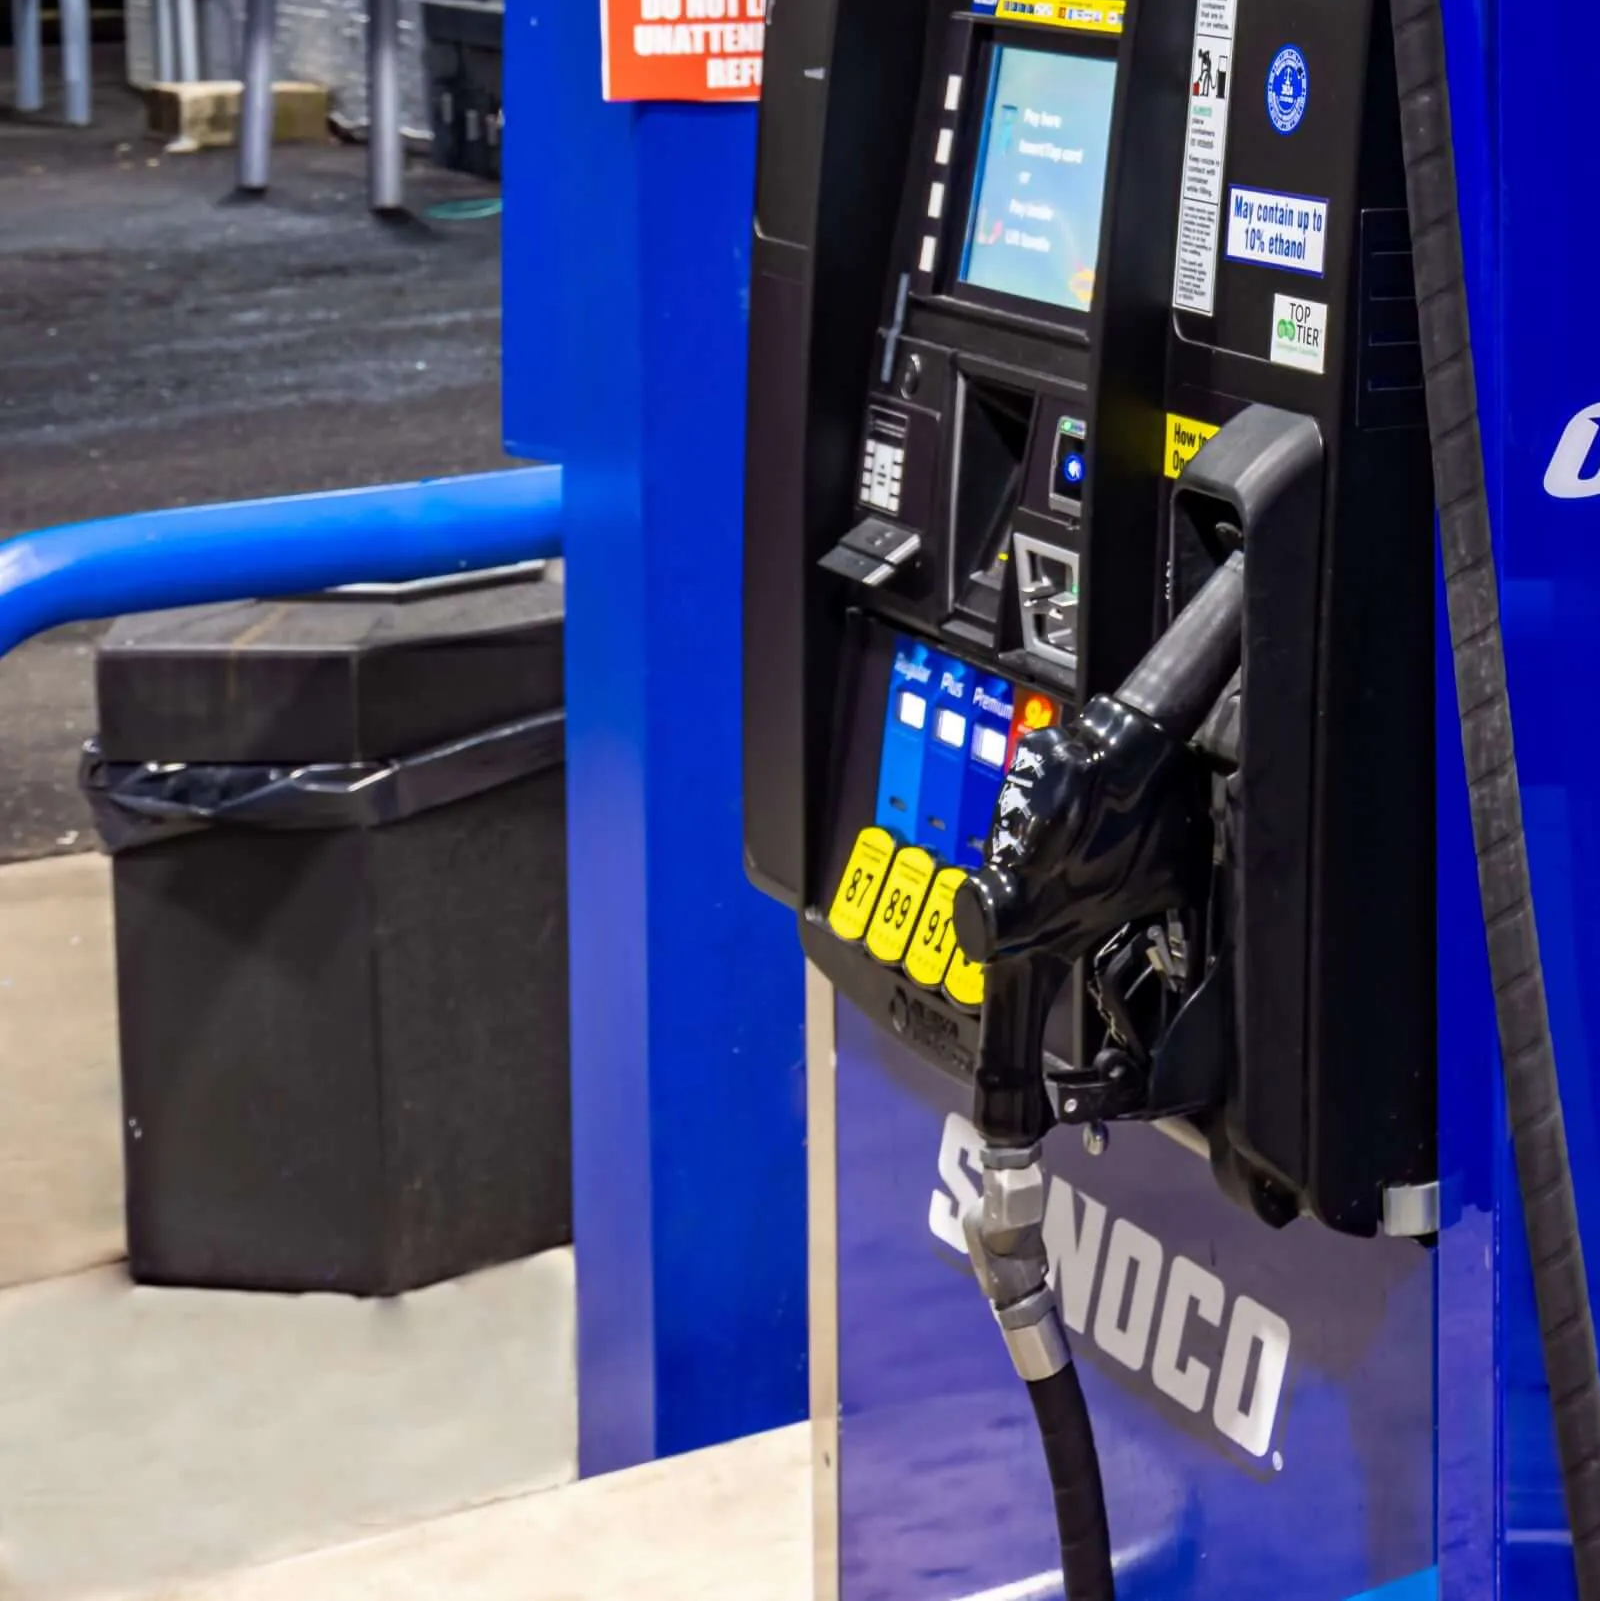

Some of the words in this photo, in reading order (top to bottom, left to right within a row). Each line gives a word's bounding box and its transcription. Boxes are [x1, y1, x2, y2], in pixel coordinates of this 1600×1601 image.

[1234, 195, 1254, 225] May
[1256, 202, 1294, 228] contain
[1297, 209, 1311, 234] up
[1312, 208, 1323, 232] to
[1244, 227, 1265, 253] 10%
[1268, 232, 1306, 261] ethanol
[1289, 302, 1311, 323] TOP
[1296, 324, 1320, 348] TIER
[1174, 422, 1196, 448] How
[940, 671, 965, 699] Plus
[972, 686, 1015, 720] Premium
[845, 867, 874, 909] 87
[883, 888, 912, 930] 89
[923, 910, 953, 953] 91
[928, 1111, 1291, 1458] SNOCO
